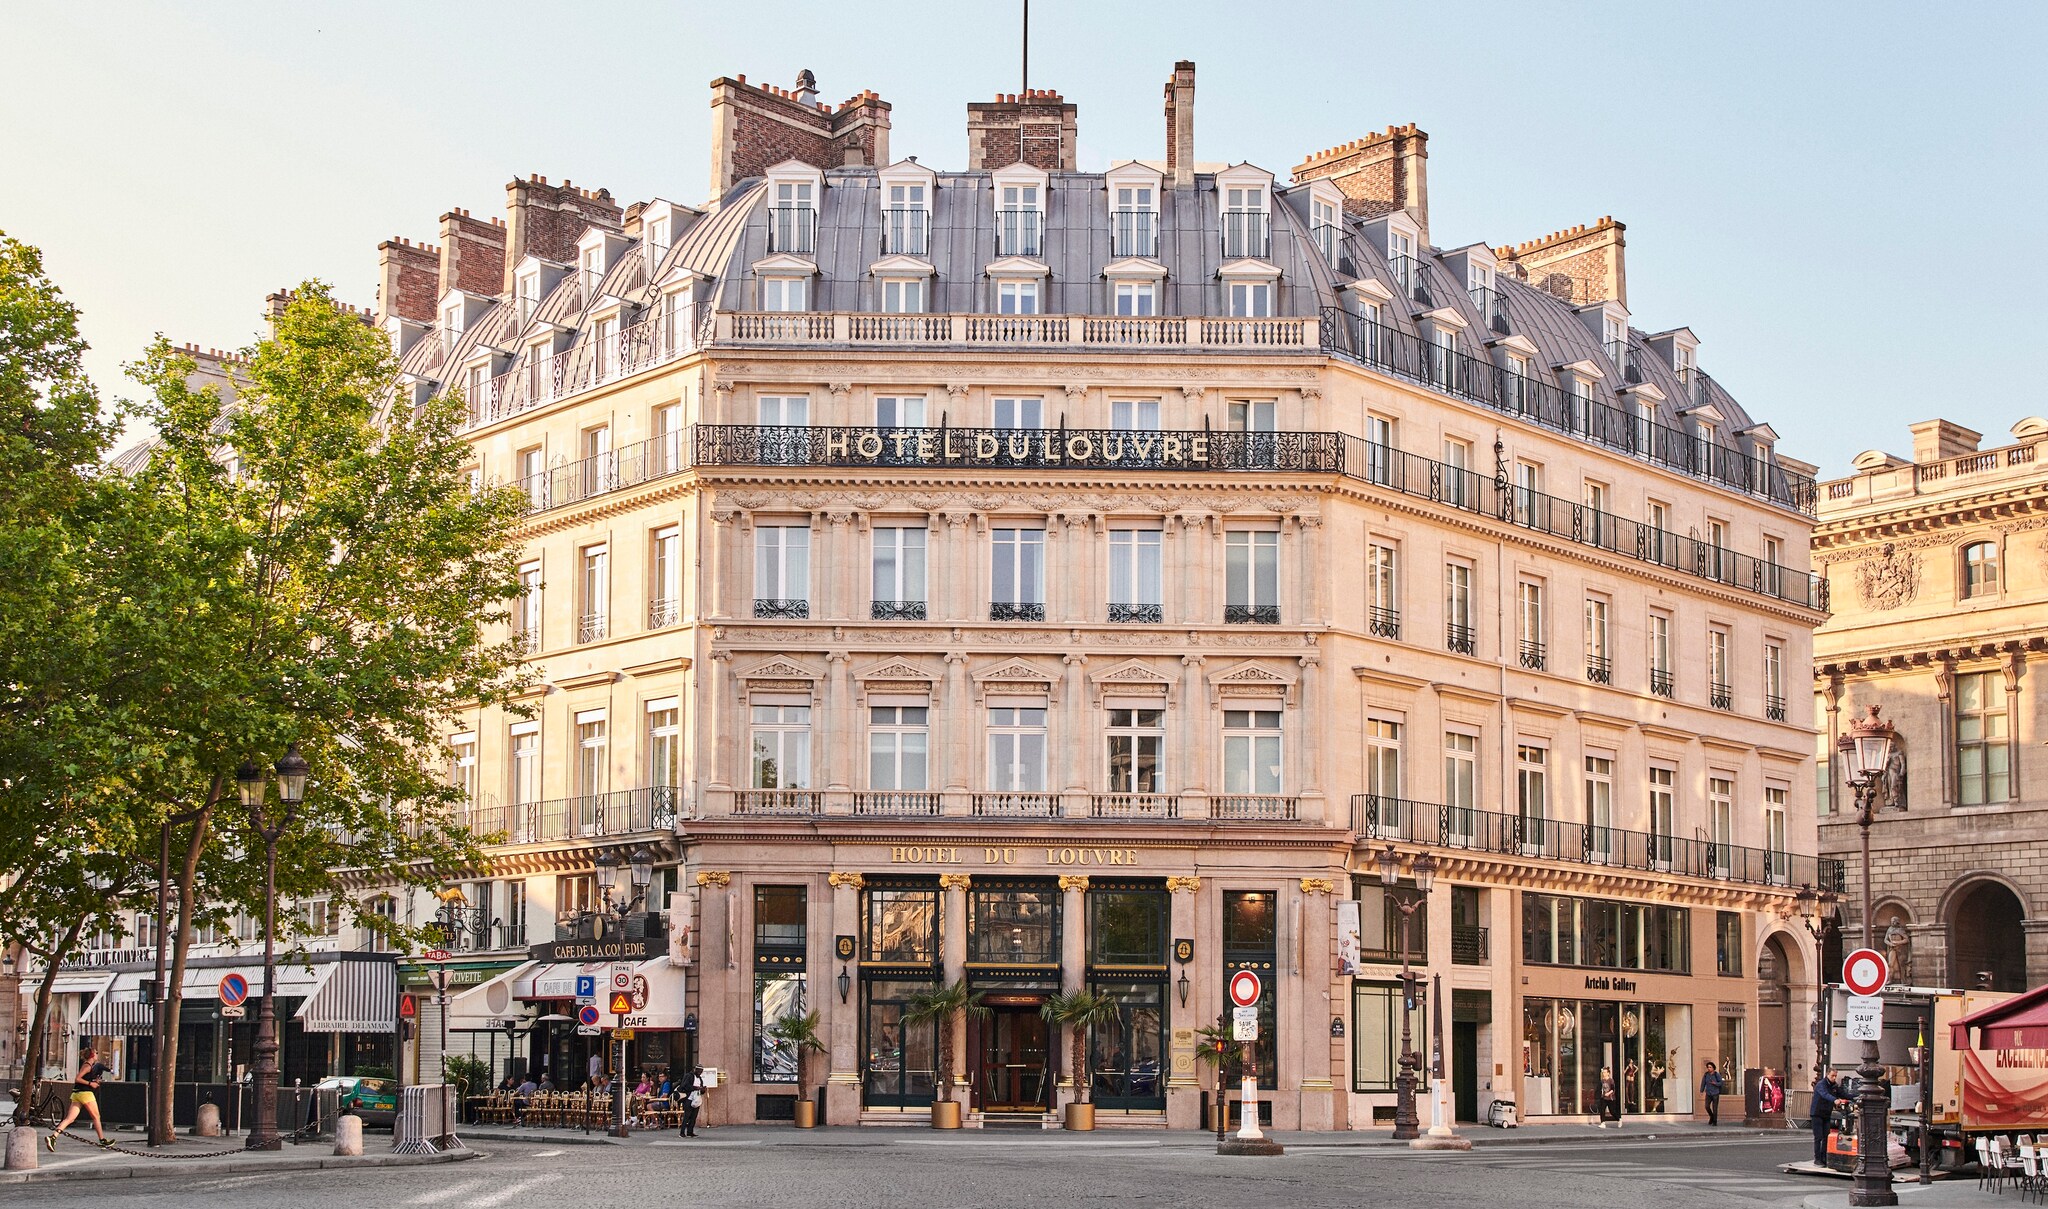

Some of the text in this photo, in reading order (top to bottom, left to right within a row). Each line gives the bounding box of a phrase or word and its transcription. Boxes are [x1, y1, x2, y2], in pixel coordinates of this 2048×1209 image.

[825, 432, 1209, 463] HOTEL DU LOUVRE
[890, 846, 1139, 865] HOTEL DU LOUVRE
[427, 951, 452, 960] TABAC
[554, 945, 576, 958] CAFE
[576, 944, 589, 957] DE
[590, 944, 604, 956] LA
[454, 972, 482, 982] CIVETTE
[581, 980, 590, 993] P
[1585, 976, 1637, 995] Artclub Gallery
[624, 1016, 648, 1027] CAFE
[1854, 1014, 1873, 1022] SAUF
[313, 1021, 348, 1029] LIBRAIRIE
